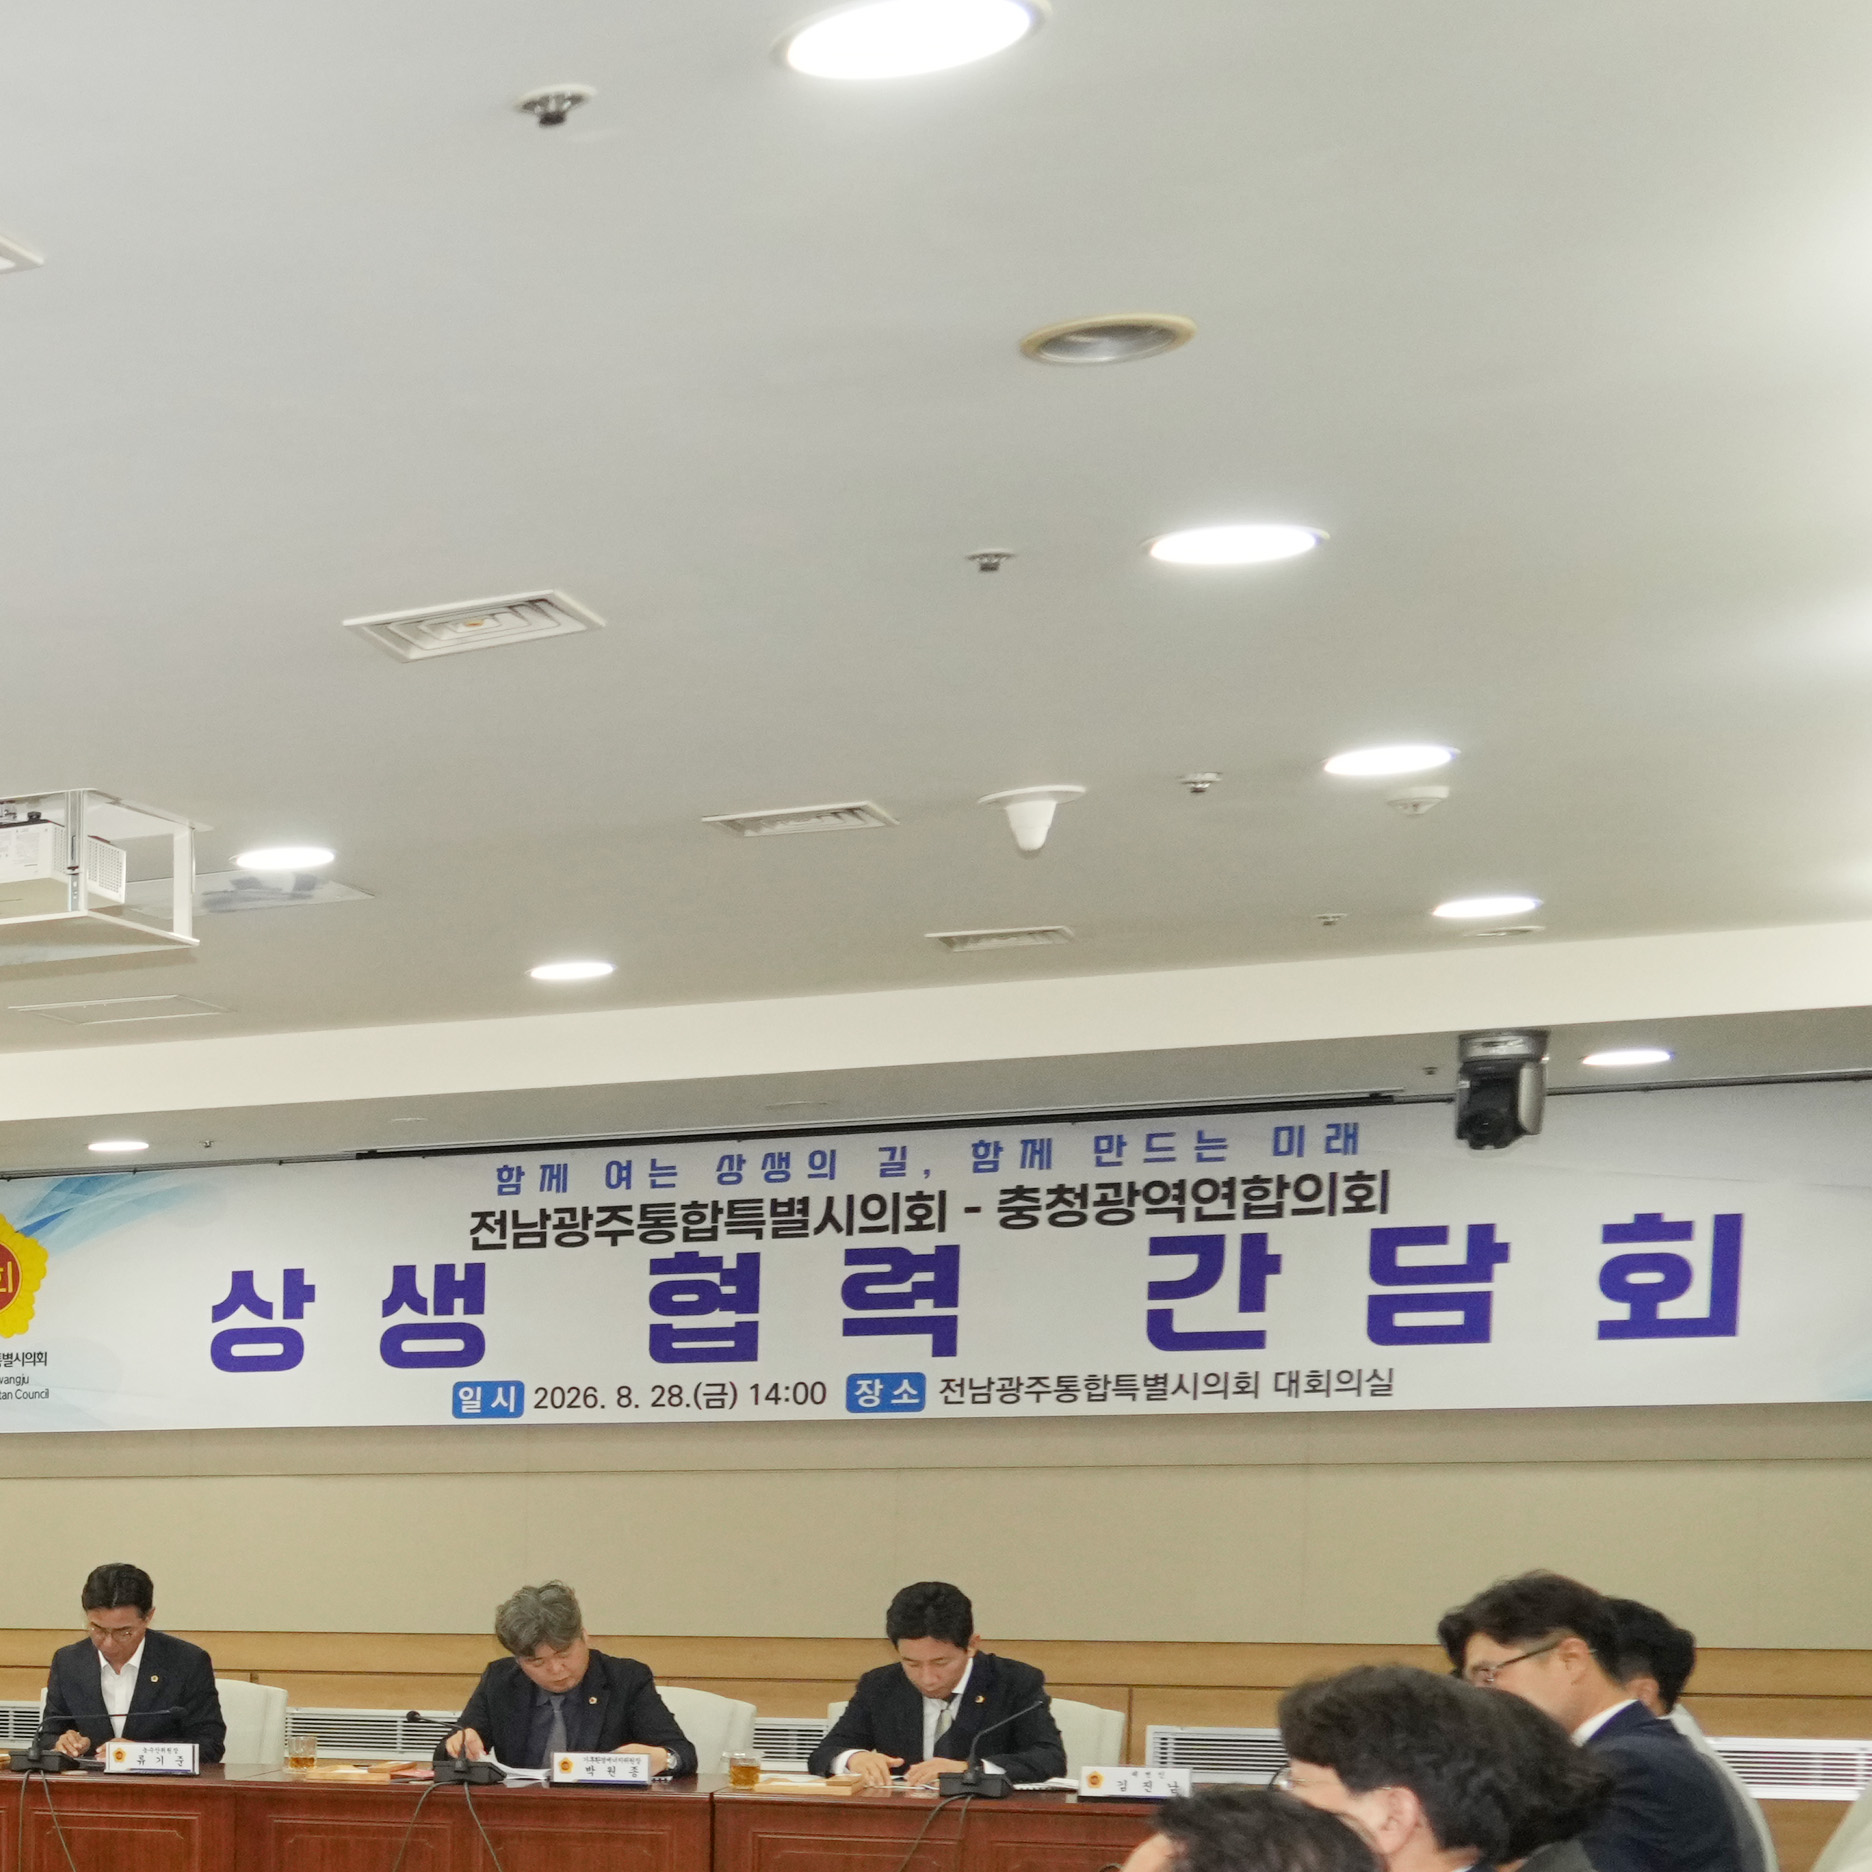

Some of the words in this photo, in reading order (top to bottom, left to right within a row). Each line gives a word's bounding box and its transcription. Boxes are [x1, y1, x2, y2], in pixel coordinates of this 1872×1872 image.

[496, 1163, 569, 1196] 함께
[605, 1158, 678, 1191] 여는
[715, 1148, 837, 1187] 상생의
[878, 1145, 931, 1179] 길,
[971, 1137, 1053, 1174] 함께
[1093, 1129, 1229, 1168] 만드는
[1272, 1122, 1359, 1158] 미래
[469, 1189, 948, 1251] 전남광주통합특별시의회
[996, 1169, 1390, 1230] 충청광역연합의회
[210, 1262, 486, 1374] 상생
[648, 1244, 960, 1364] 협력
[1146, 1212, 1744, 1352] 간담회
[15, 1387, 49, 1401] Council
[457, 1385, 518, 1414] 일시
[533, 1385, 606, 1410] 2026.
[616, 1385, 640, 1409] 8.
[650, 1380, 738, 1411] 28.(금)
[749, 1380, 827, 1406] 14:00
[853, 1379, 922, 1408] 장소
[938, 1370, 1260, 1405] 전남광주통합특별시의회
[1274, 1367, 1394, 1399] 대회의실
[585, 1765, 640, 1778] 박원종
